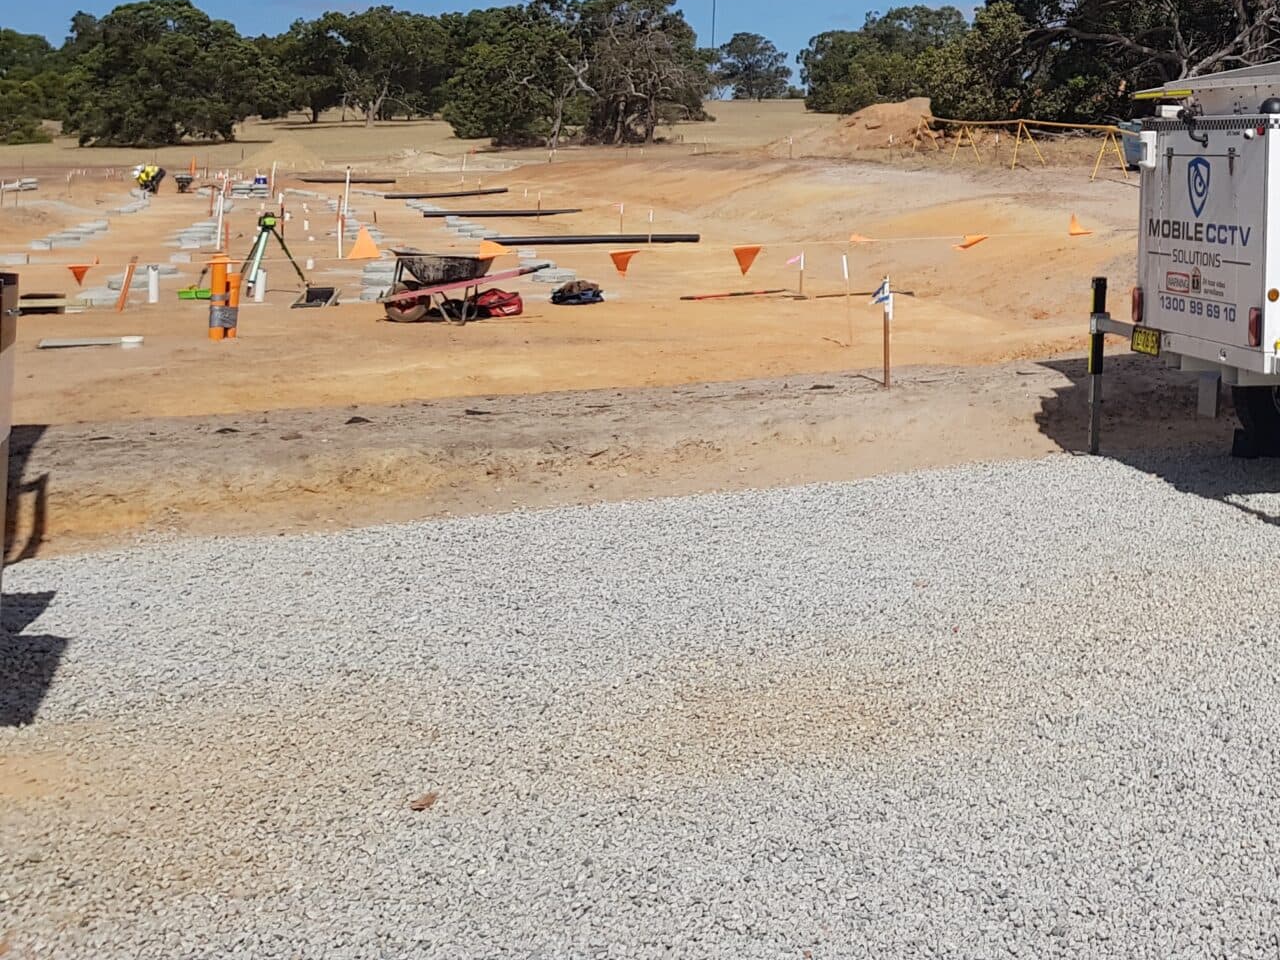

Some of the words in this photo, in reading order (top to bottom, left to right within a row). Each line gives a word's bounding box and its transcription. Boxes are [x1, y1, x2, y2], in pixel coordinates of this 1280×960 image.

[1148, 218, 1204, 242] MOBILE
[1206, 223, 1251, 247] CCTV
[1172, 249, 1221, 268] SOLUTIONS
[1160, 295, 1186, 312] 1300
[1190, 300, 1203, 316] 99
[1206, 304, 1220, 319] 69
[1223, 307, 1236, 322] 10
